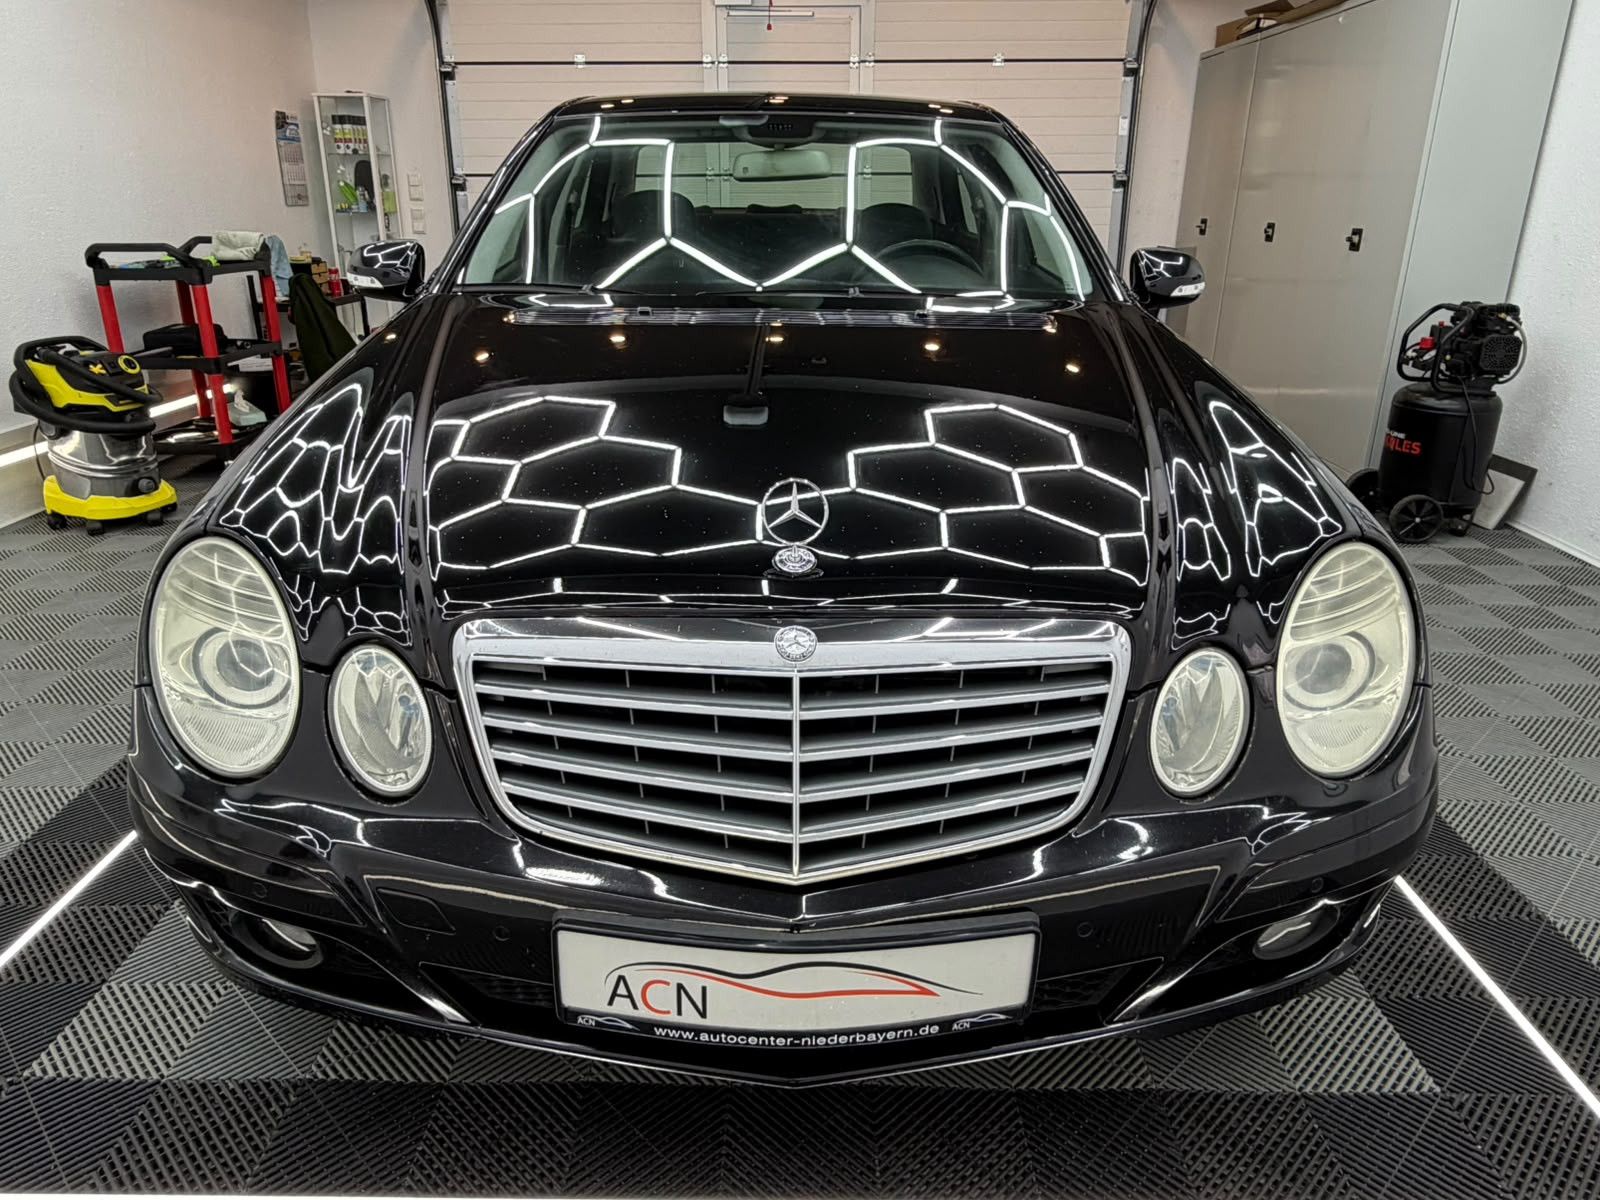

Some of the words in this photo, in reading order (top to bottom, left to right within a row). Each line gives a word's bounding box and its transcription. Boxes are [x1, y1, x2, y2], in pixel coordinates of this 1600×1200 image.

[607, 974, 708, 1019] ACN
[577, 1017, 596, 1027] ACN
[952, 1022, 970, 1031] ACN
[653, 1024, 940, 1046] www.autocenter-niederbayern.de
